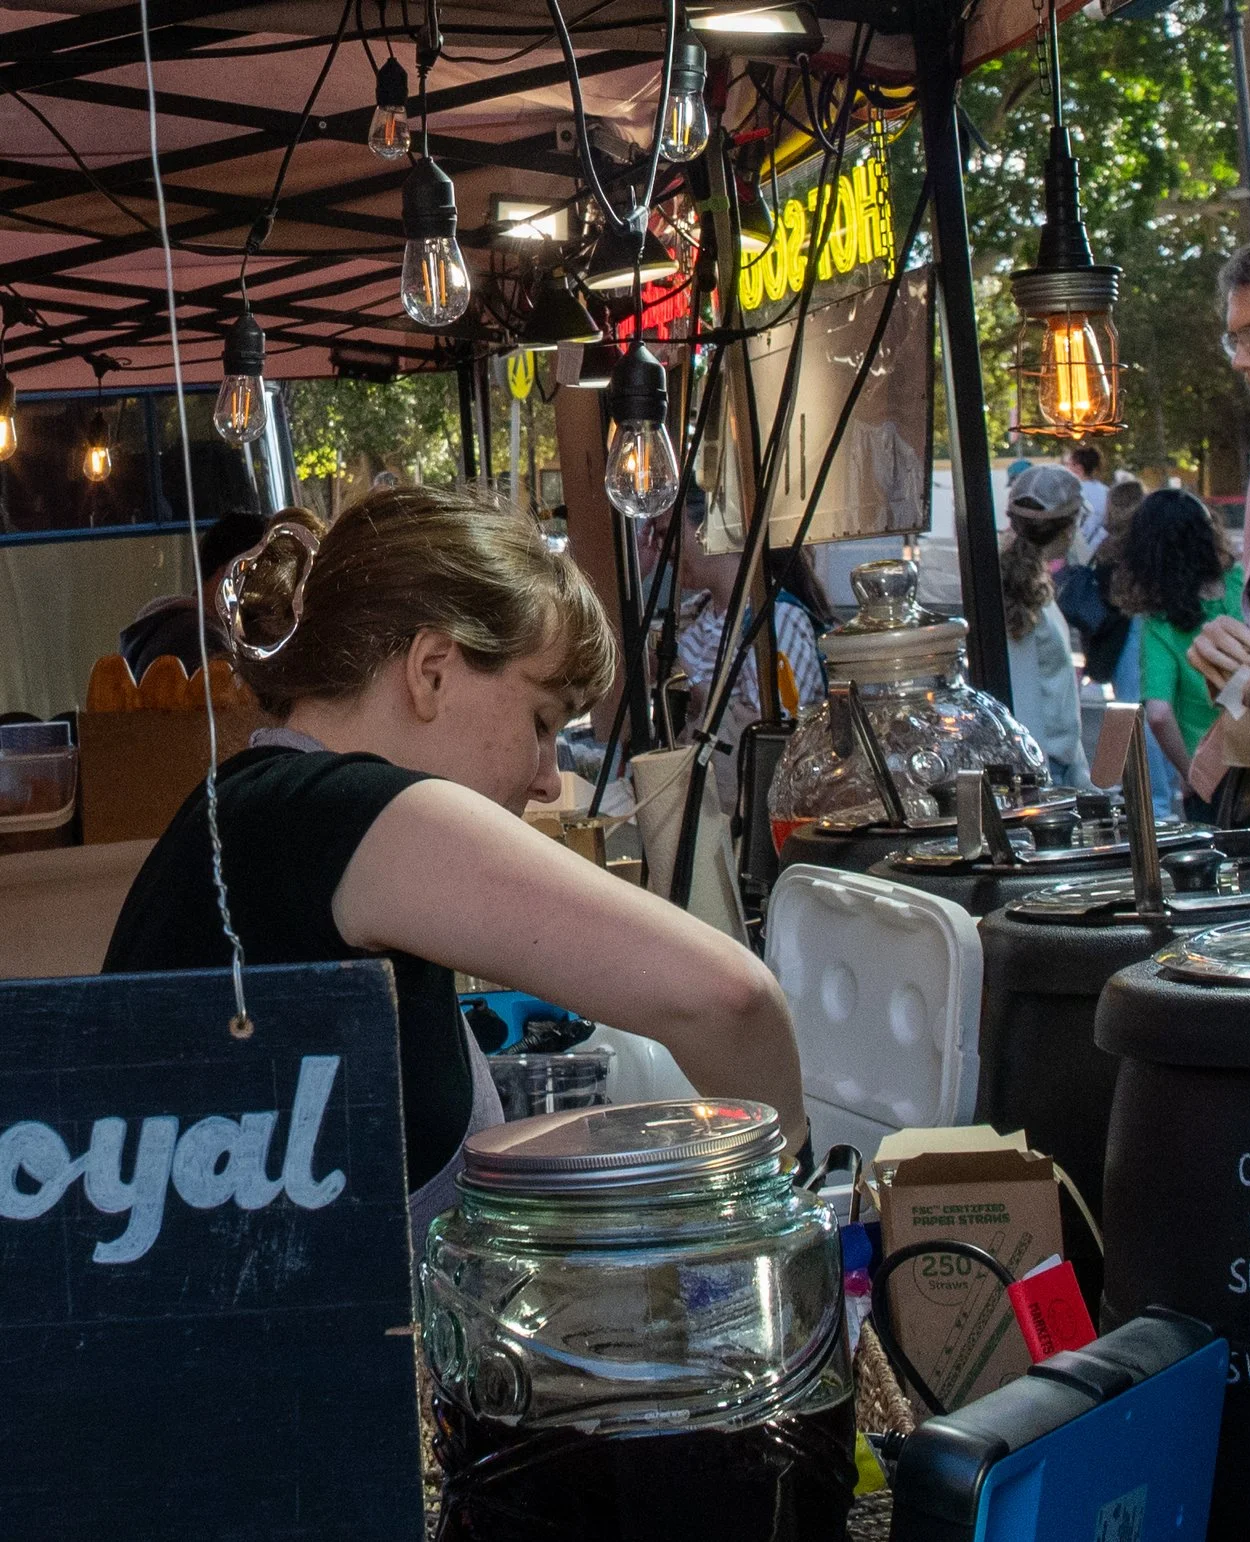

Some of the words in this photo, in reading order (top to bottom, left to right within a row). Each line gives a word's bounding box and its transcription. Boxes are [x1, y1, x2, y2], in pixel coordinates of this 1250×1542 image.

[912, 1215, 955, 1226] PAPER
[958, 1213, 1011, 1225] STRAWS
[922, 1254, 972, 1277] 250
[928, 1279, 969, 1291] Straws
